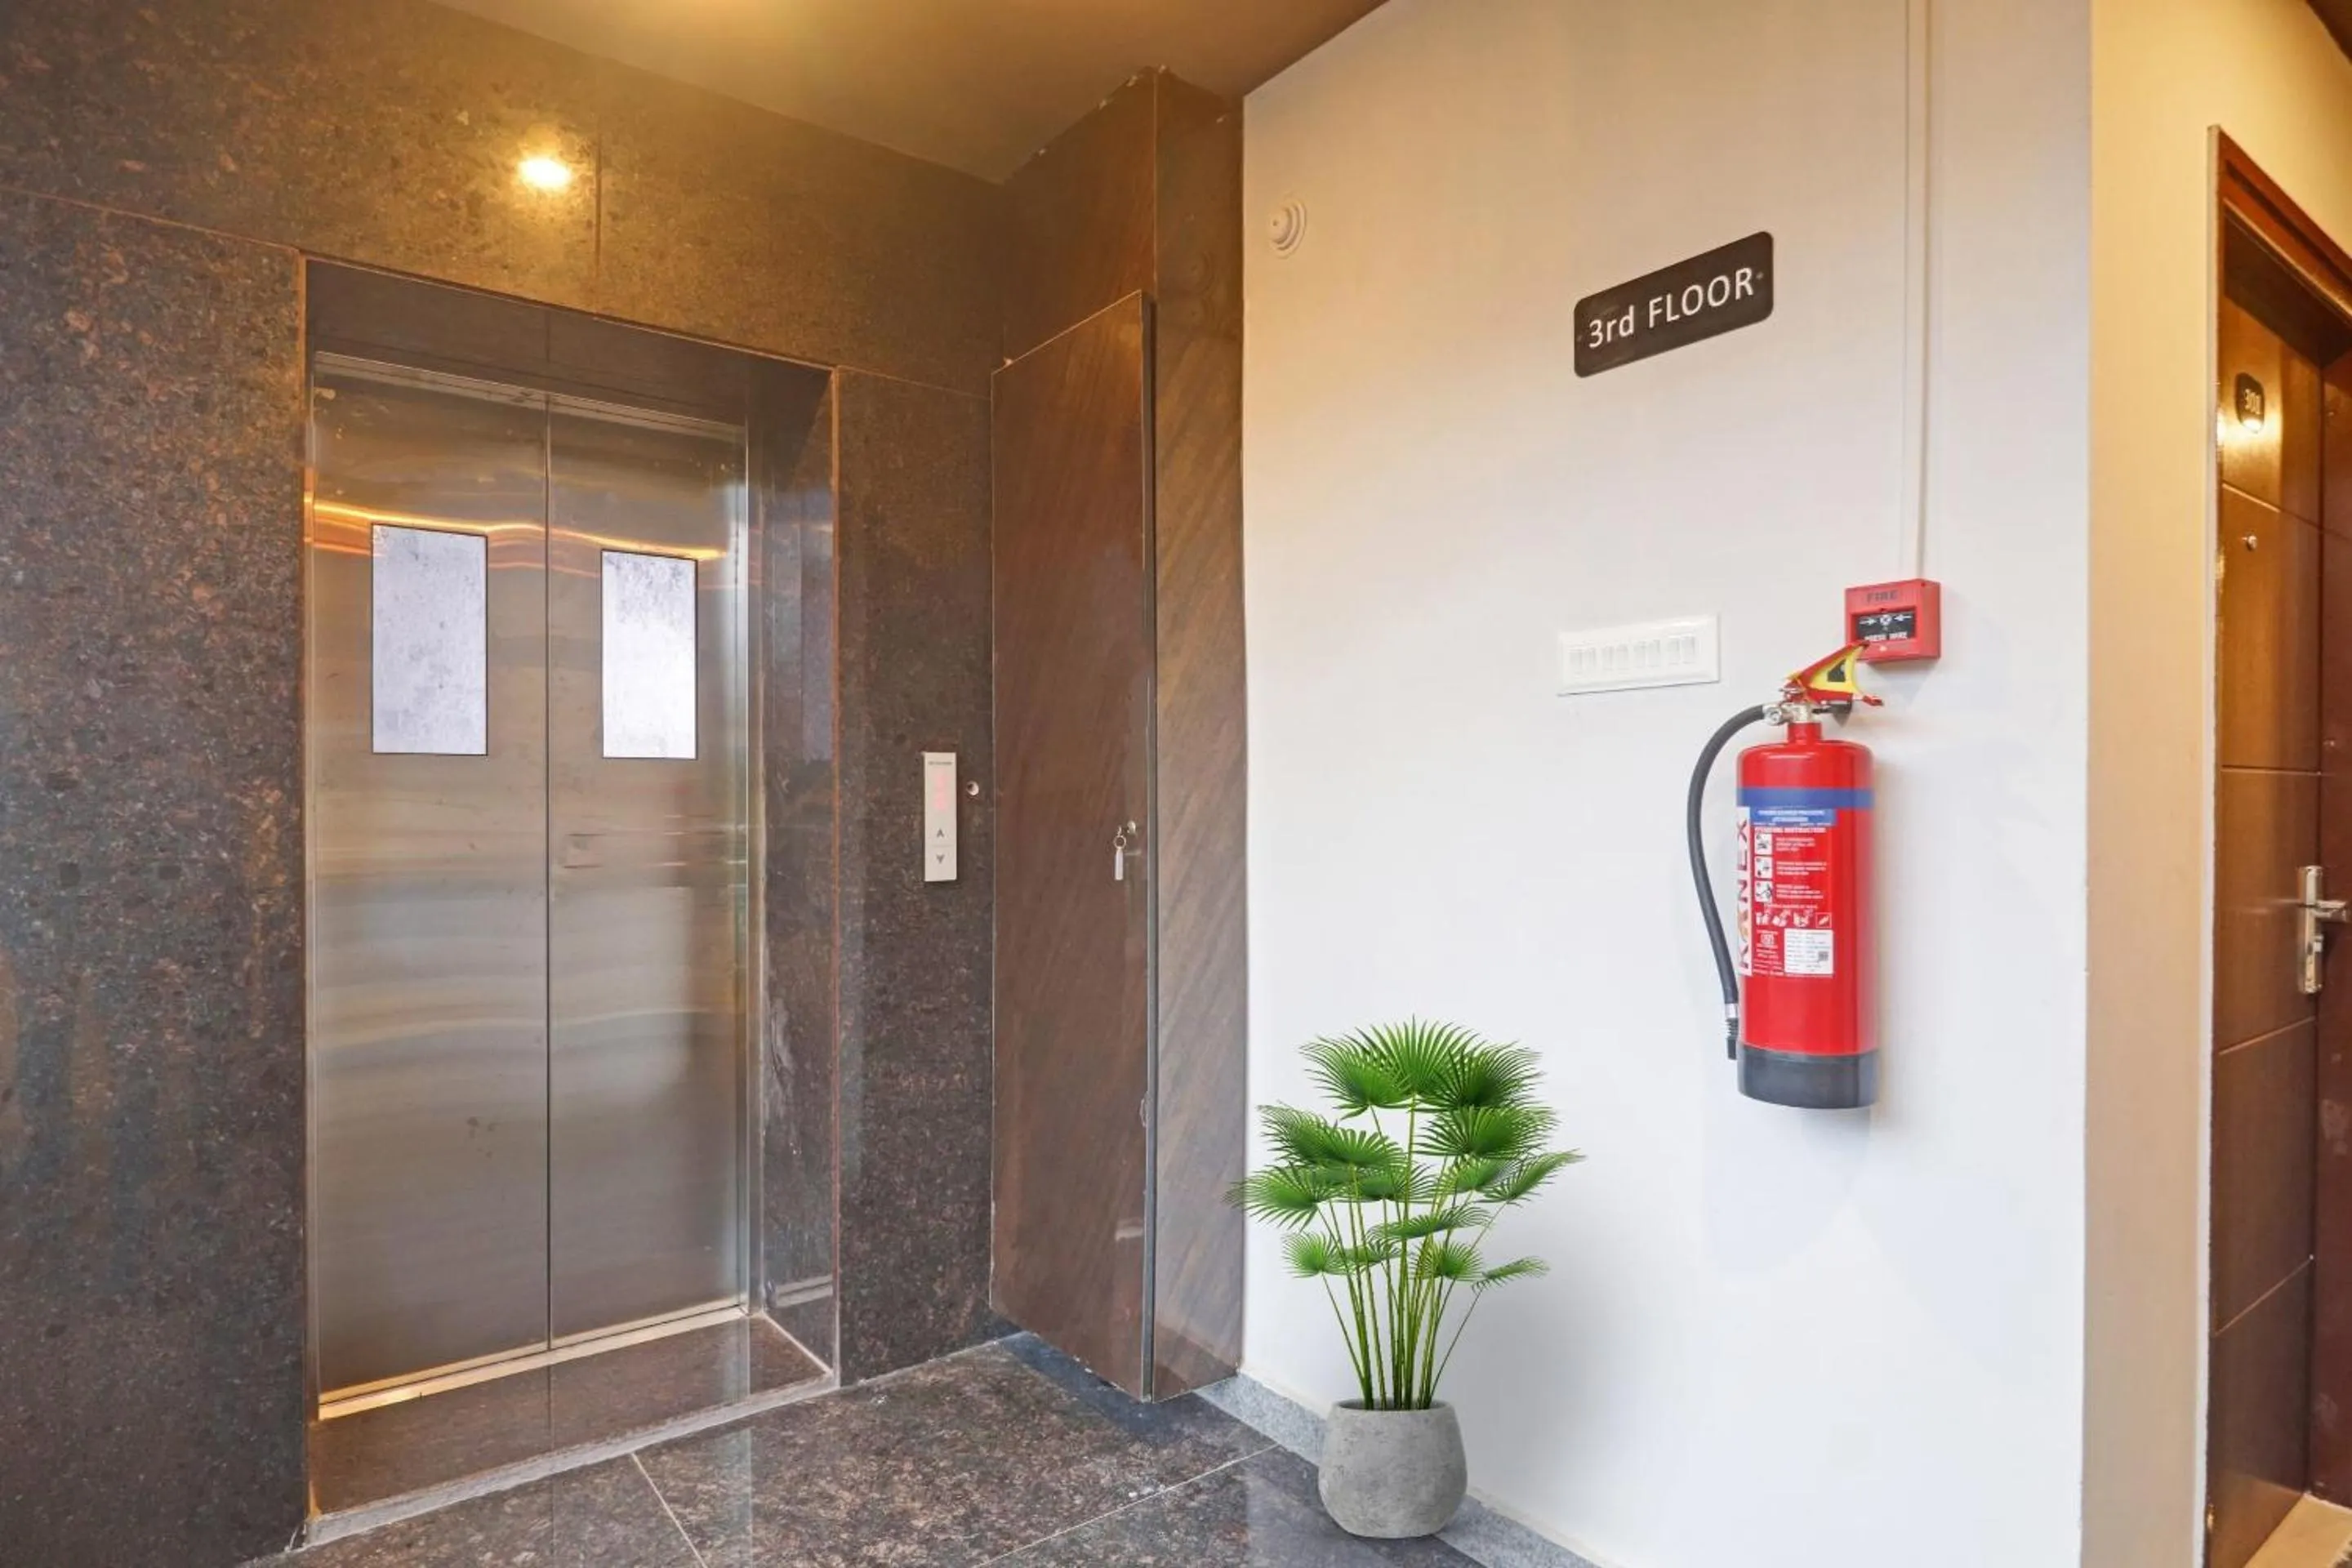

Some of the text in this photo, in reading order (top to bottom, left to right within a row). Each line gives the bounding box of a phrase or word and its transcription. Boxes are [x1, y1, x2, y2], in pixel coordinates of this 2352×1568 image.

[1588, 267, 1754, 348] 3rd FLOOR
[1867, 590, 1897, 602] FIRE
